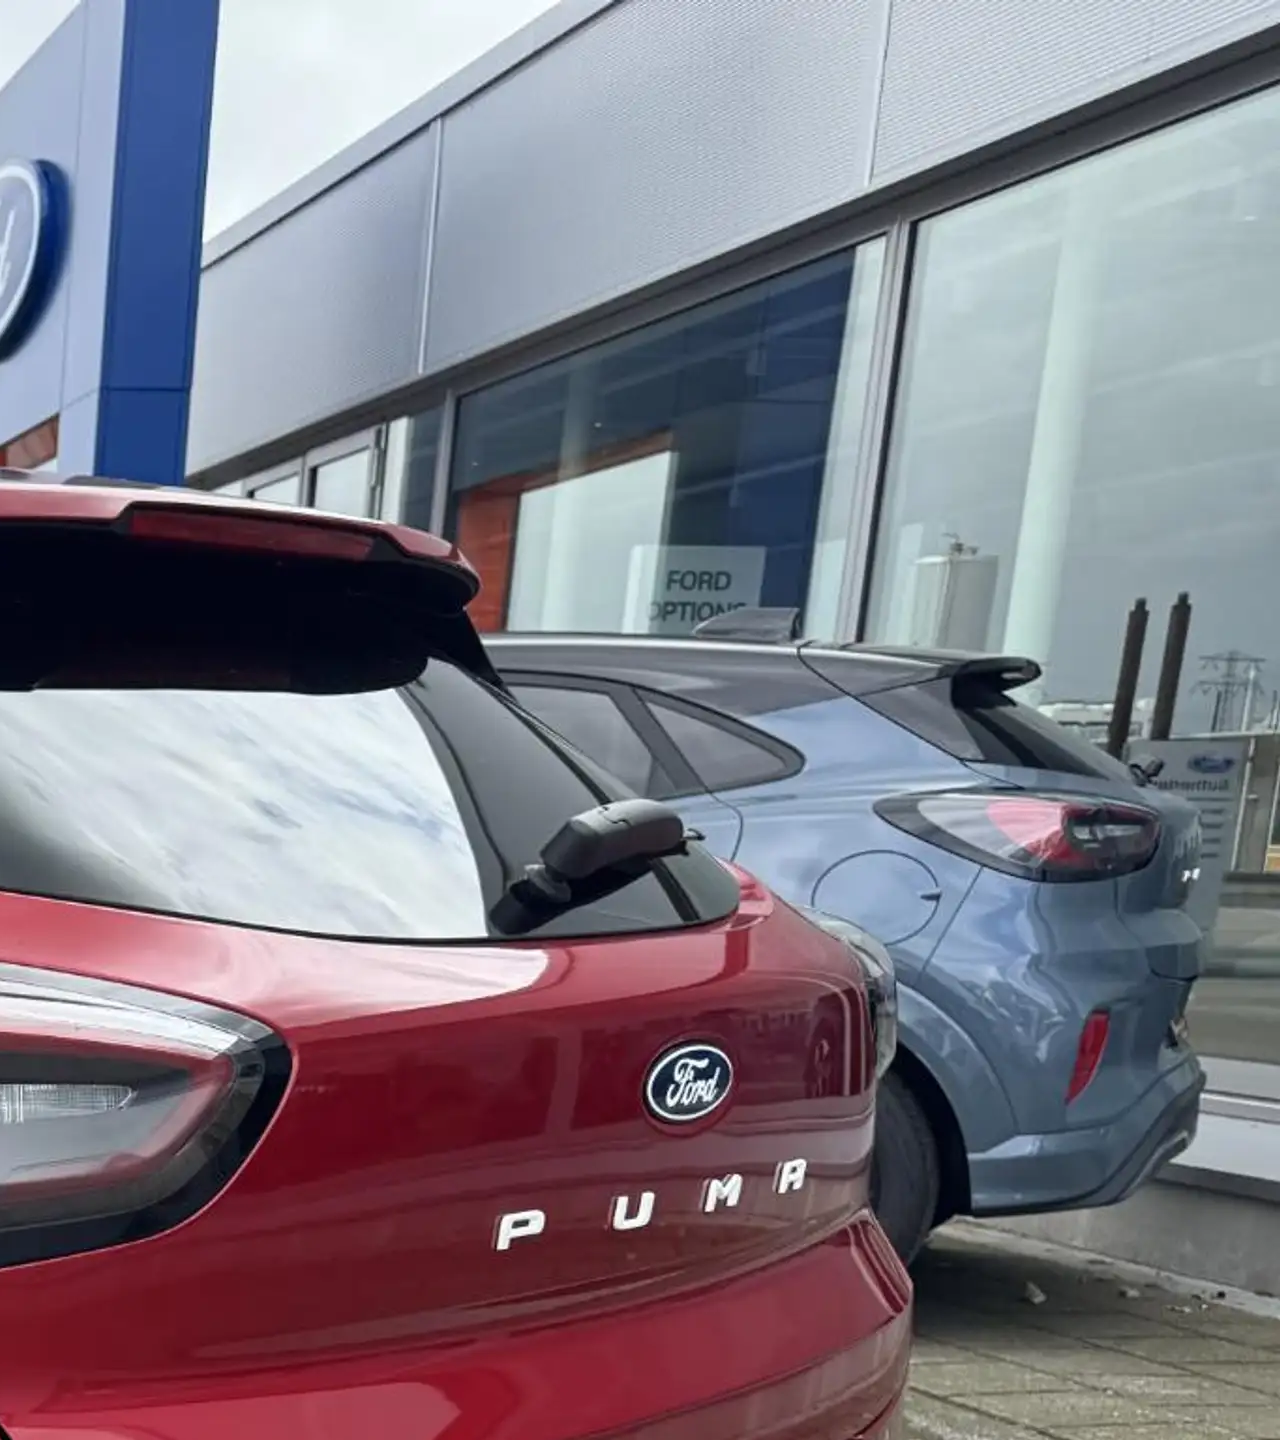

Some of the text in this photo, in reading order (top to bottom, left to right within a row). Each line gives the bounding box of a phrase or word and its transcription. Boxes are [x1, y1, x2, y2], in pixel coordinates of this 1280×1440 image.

[666, 569, 732, 591] FORD
[666, 1057, 721, 1108] Ford
[494, 1157, 808, 1251] PUMA
